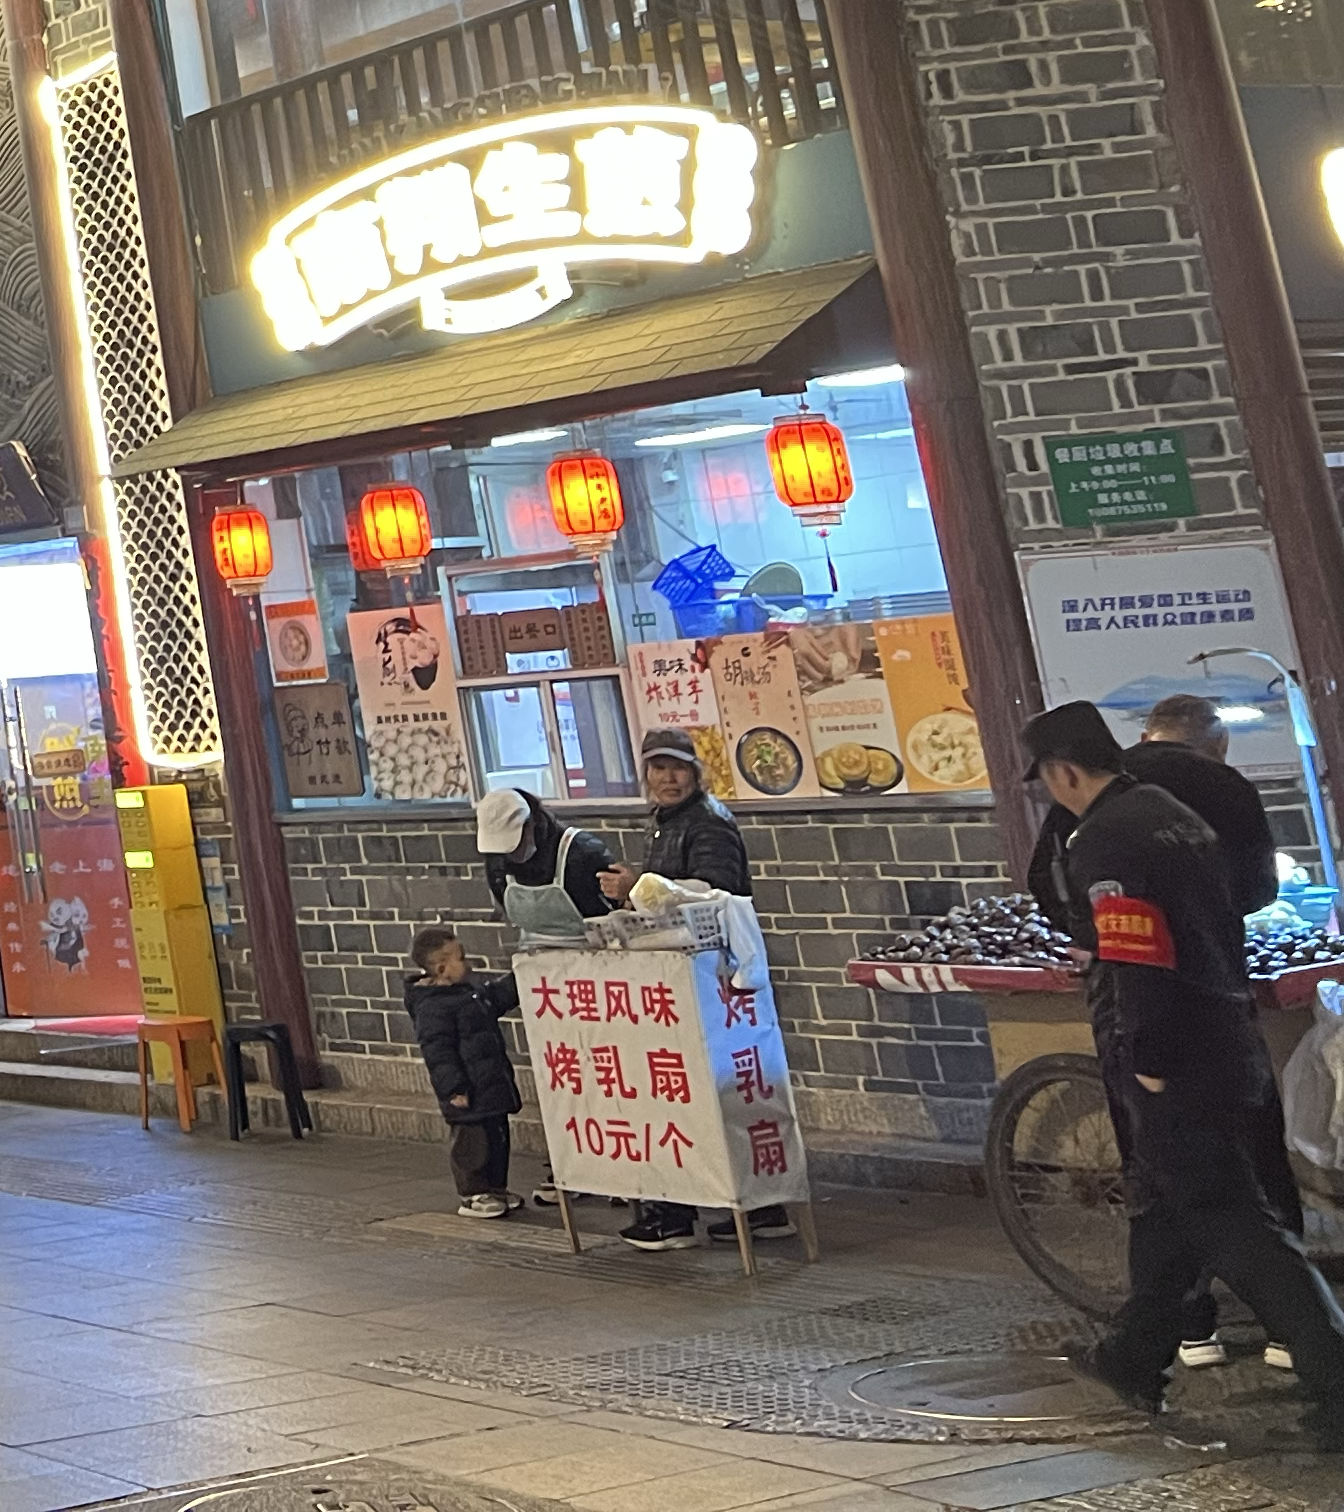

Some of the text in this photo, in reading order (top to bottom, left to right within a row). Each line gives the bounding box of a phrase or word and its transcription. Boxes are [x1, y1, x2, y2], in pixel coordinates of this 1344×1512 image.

[1062, 589, 1251, 614] 深入开展爱国卫生运动
[645, 676, 704, 708] 炸洋芋
[313, 710, 347, 730] 点单
[316, 738, 353, 757] 付款
[531, 976, 680, 1028] 大理风味
[543, 1041, 691, 1104] 烤乳扇
[717, 975, 788, 1177] 烤乳扇
[565, 1116, 694, 1169] 10元/个
